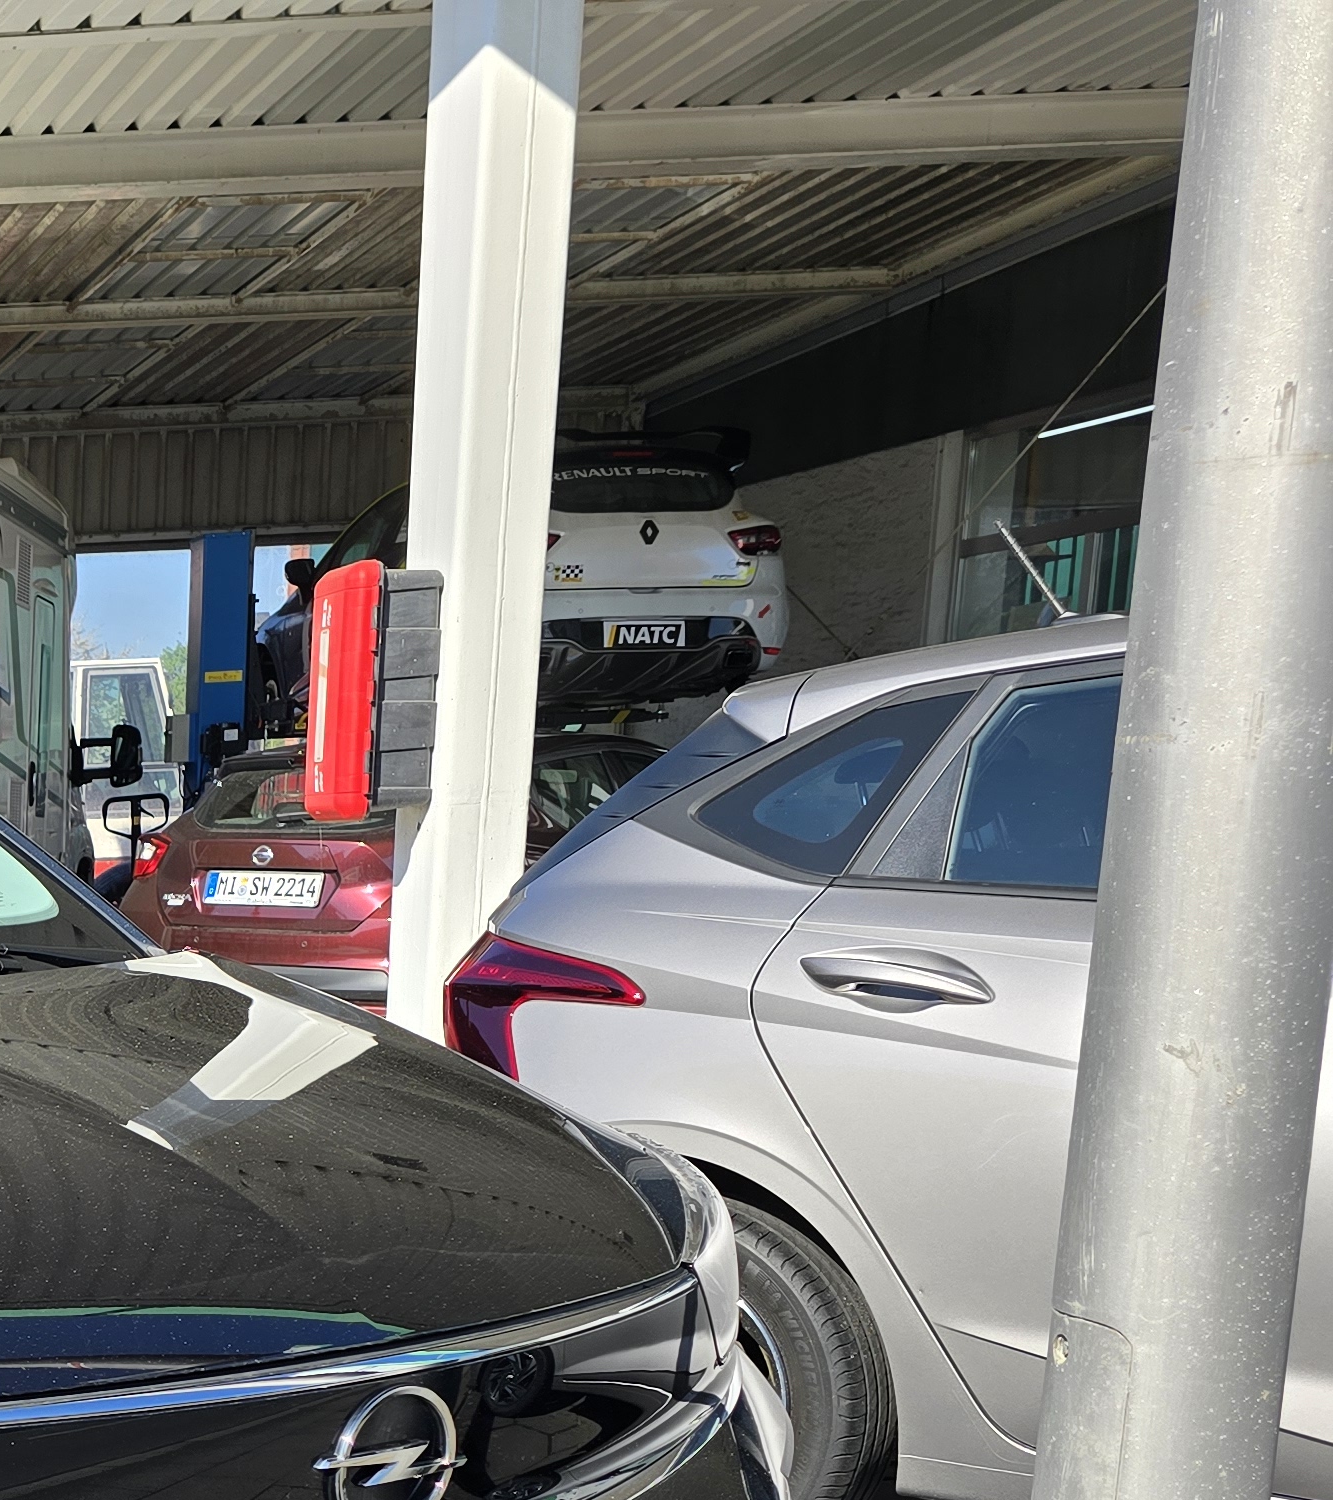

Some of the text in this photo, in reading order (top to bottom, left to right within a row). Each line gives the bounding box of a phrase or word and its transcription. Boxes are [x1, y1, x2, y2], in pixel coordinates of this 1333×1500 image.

[554, 466, 709, 482] RENAULT SPORT
[618, 626, 676, 645] NATC
[218, 876, 316, 898] MI SW 2214
